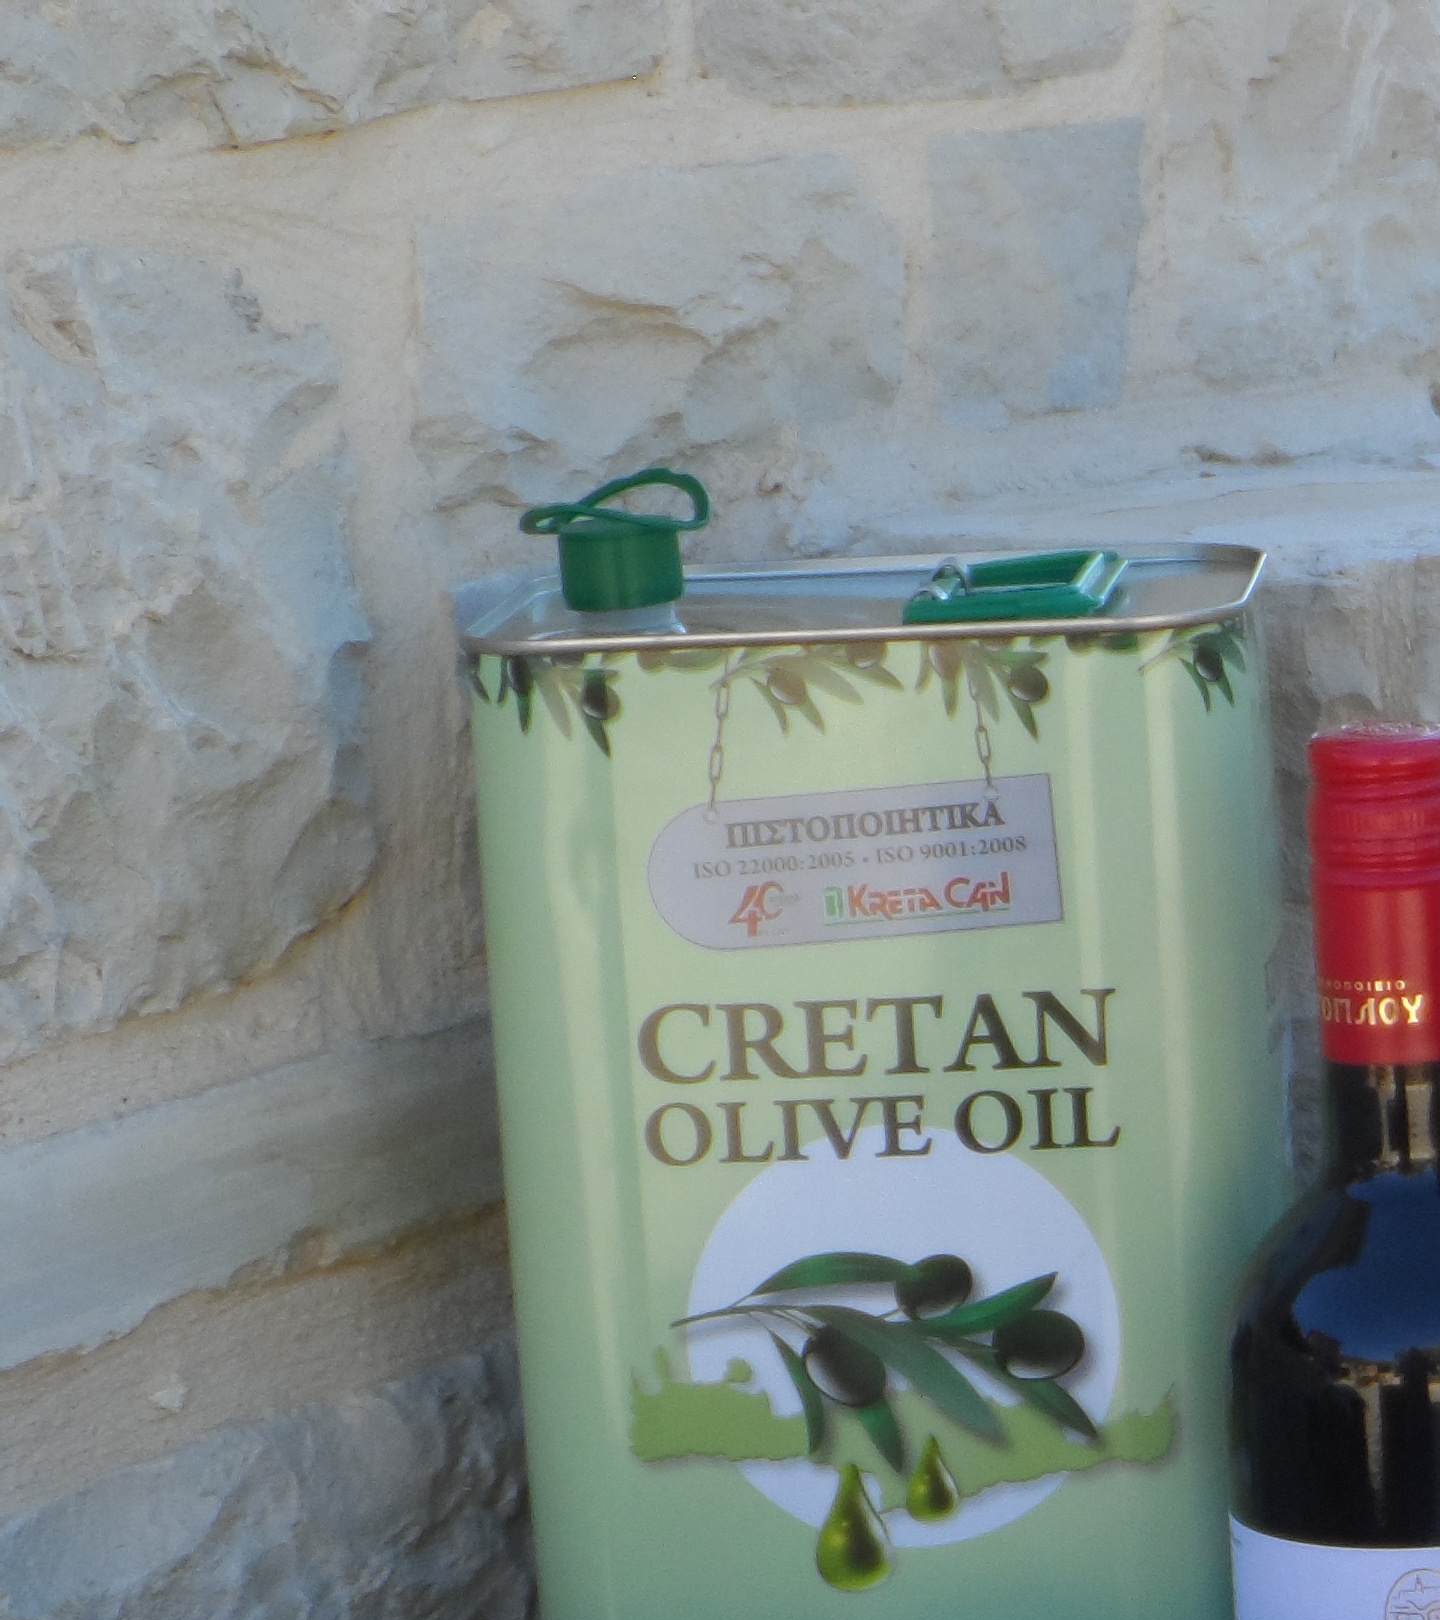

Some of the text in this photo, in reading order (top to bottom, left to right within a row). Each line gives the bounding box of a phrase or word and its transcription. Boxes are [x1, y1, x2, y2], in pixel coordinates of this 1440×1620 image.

[725, 800, 1005, 849] ΠΙΣΤΟΠΟΙΗΤΙΚΑ
[693, 860, 732, 879] ISO
[738, 853, 855, 876] 22000:2005
[876, 846, 914, 865] ISO
[920, 836, 1028, 860] 9001:2008
[638, 988, 1116, 1085] CRETAN
[644, 1087, 1121, 1167] OLIVE OIL
